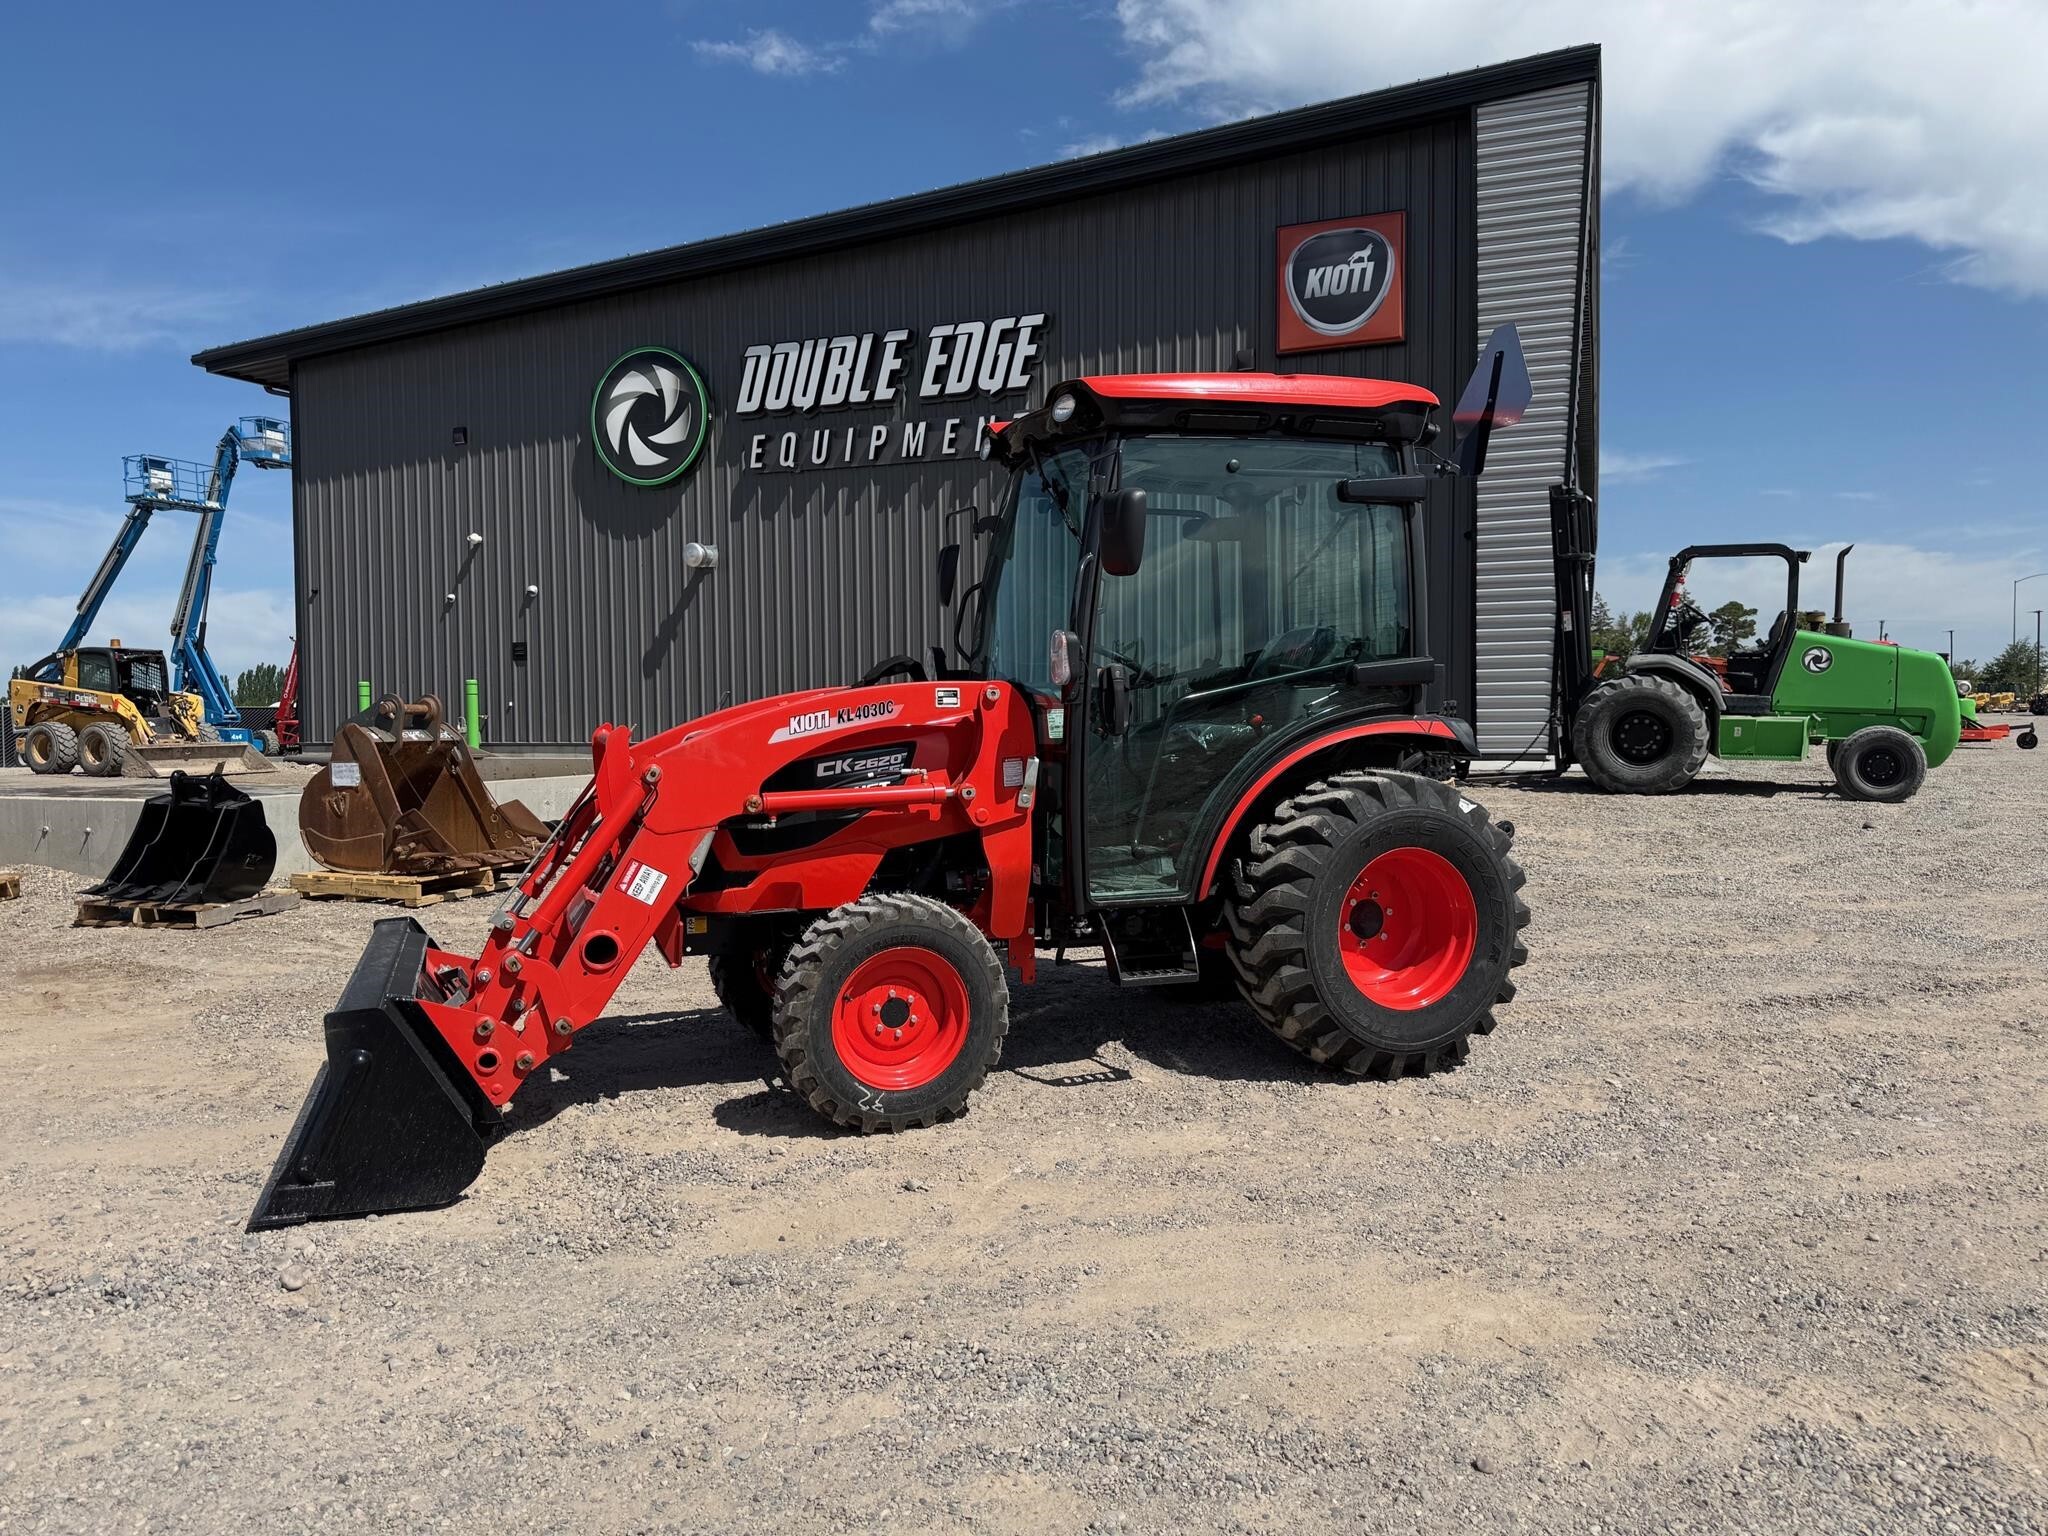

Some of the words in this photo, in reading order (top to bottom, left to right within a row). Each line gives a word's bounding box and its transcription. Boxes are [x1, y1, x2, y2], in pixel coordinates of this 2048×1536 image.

[1304, 261, 1375, 299] KIOTI
[735, 328, 910, 414] DOUBLE
[919, 313, 1045, 397] EDGE
[789, 709, 831, 735] KIOTI
[837, 700, 894, 724] KL4030C
[816, 751, 903, 777] CK2620
[632, 882, 645, 897] KEEP
[639, 867, 653, 885] AWAY
